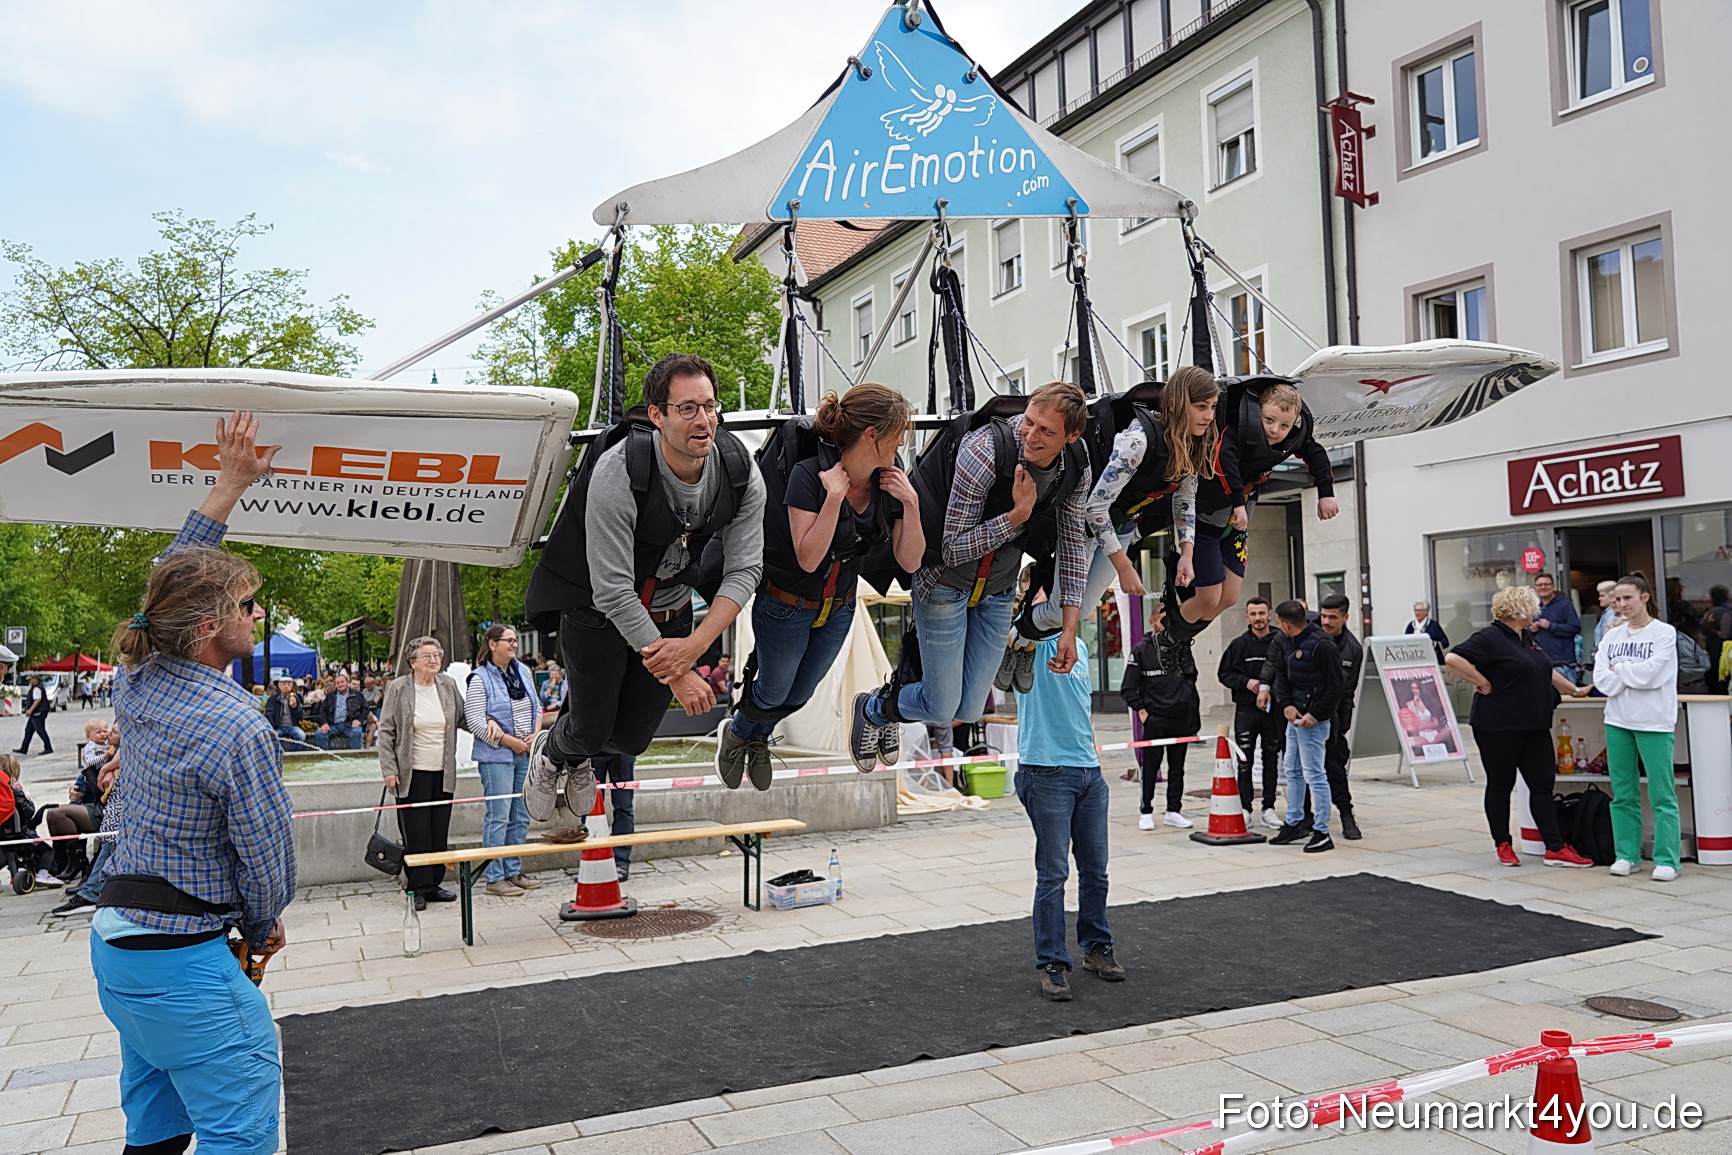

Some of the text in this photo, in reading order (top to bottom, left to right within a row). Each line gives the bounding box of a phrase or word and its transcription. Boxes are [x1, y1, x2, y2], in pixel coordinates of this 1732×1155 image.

[798, 136, 1036, 202] AirEmotion
[1339, 118, 1357, 192] Achatz
[1016, 174, 1050, 197] .com
[149, 440, 527, 485] KLEBL
[151, 473, 525, 499] DER BPARTNER IN DEUTSCHLAND
[1522, 459, 1663, 508] Achatz
[240, 498, 485, 524] www.klebl.de
[1384, 645, 1427, 661] Achatz
